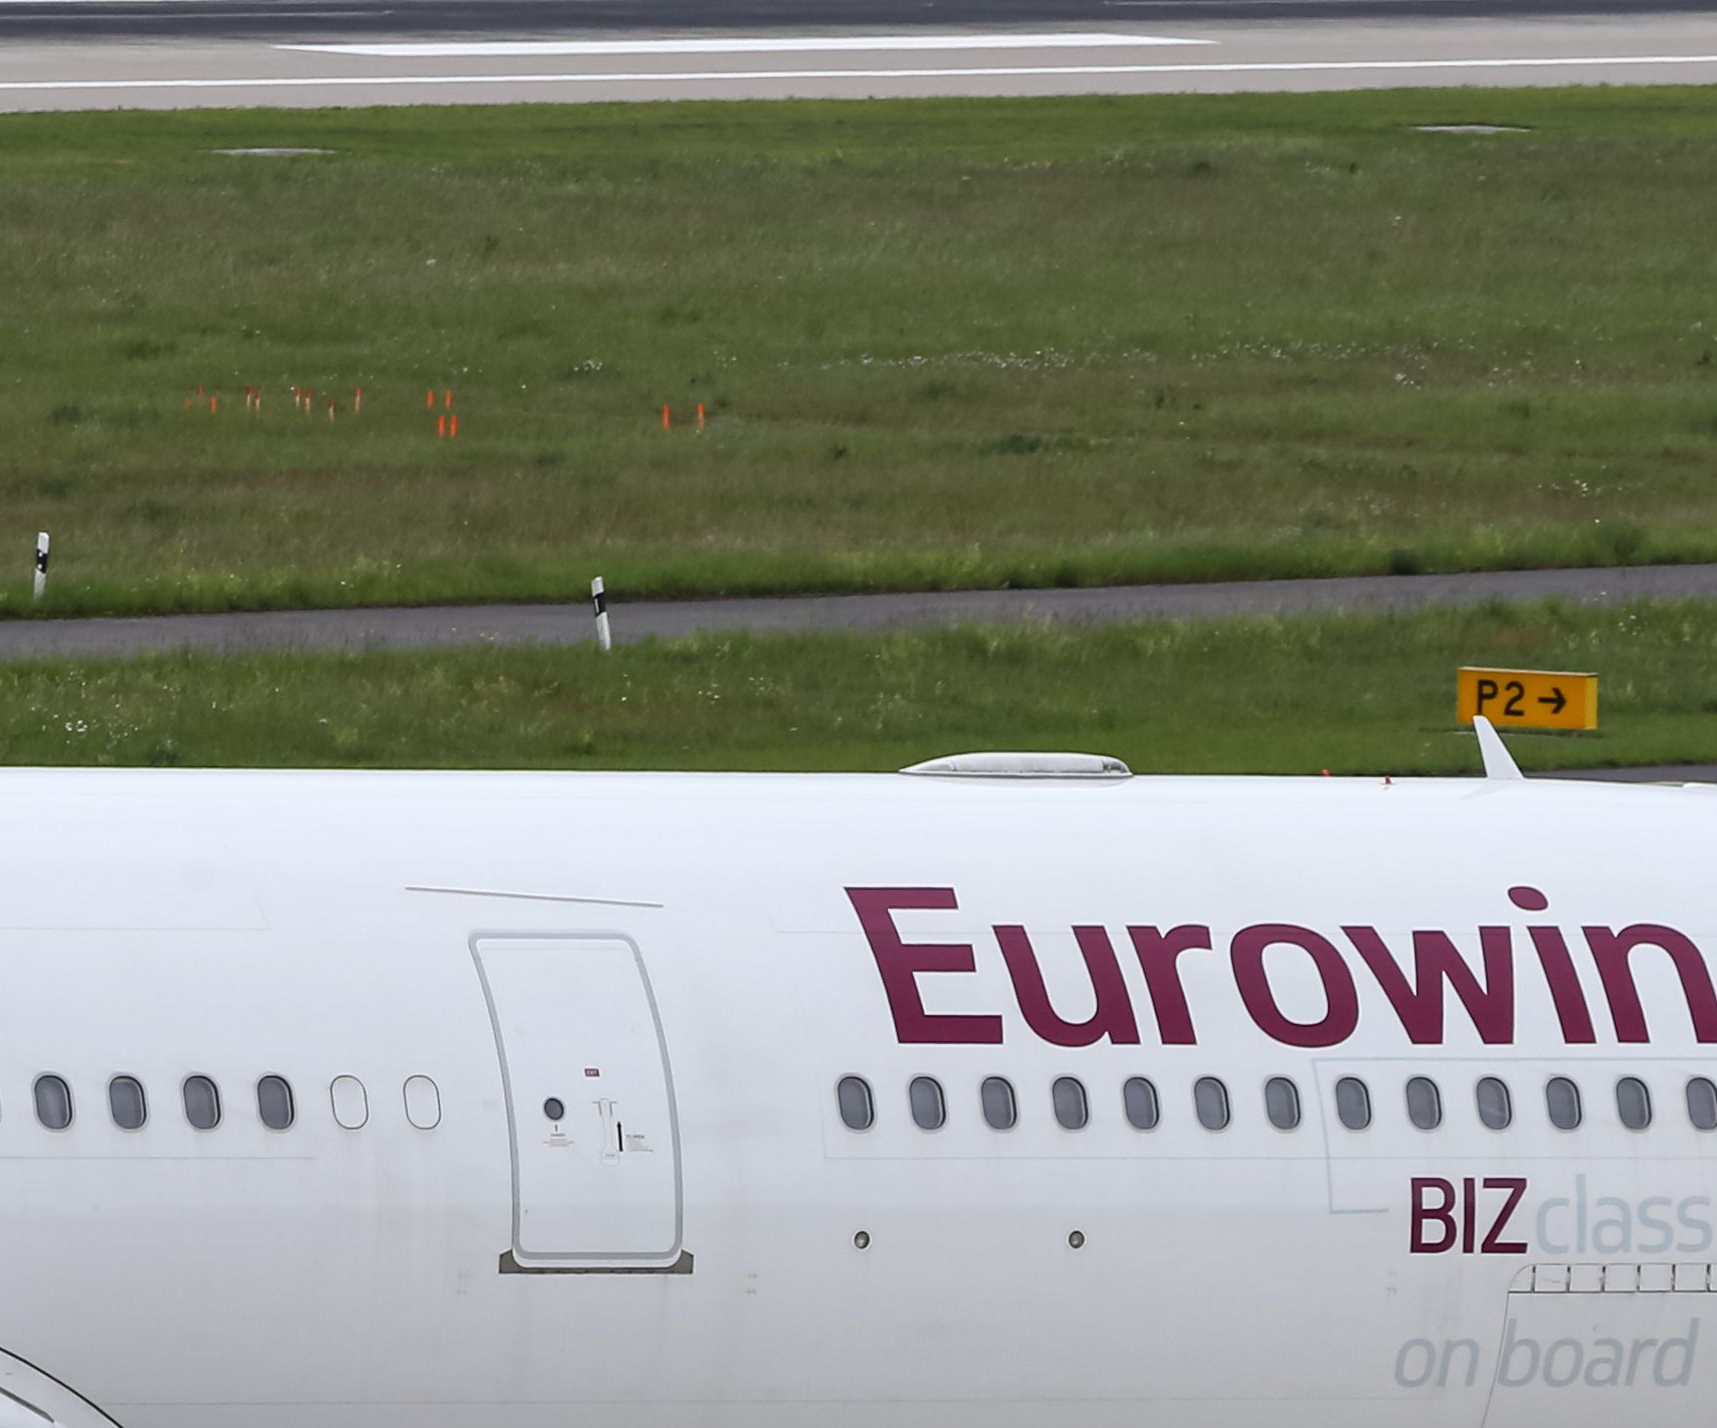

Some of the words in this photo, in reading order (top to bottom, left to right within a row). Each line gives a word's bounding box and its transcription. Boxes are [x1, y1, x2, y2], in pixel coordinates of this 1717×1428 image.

[1477, 679, 1525, 716] P2
[1393, 1335, 1482, 1389] on
[1496, 1317, 1701, 1390] board
